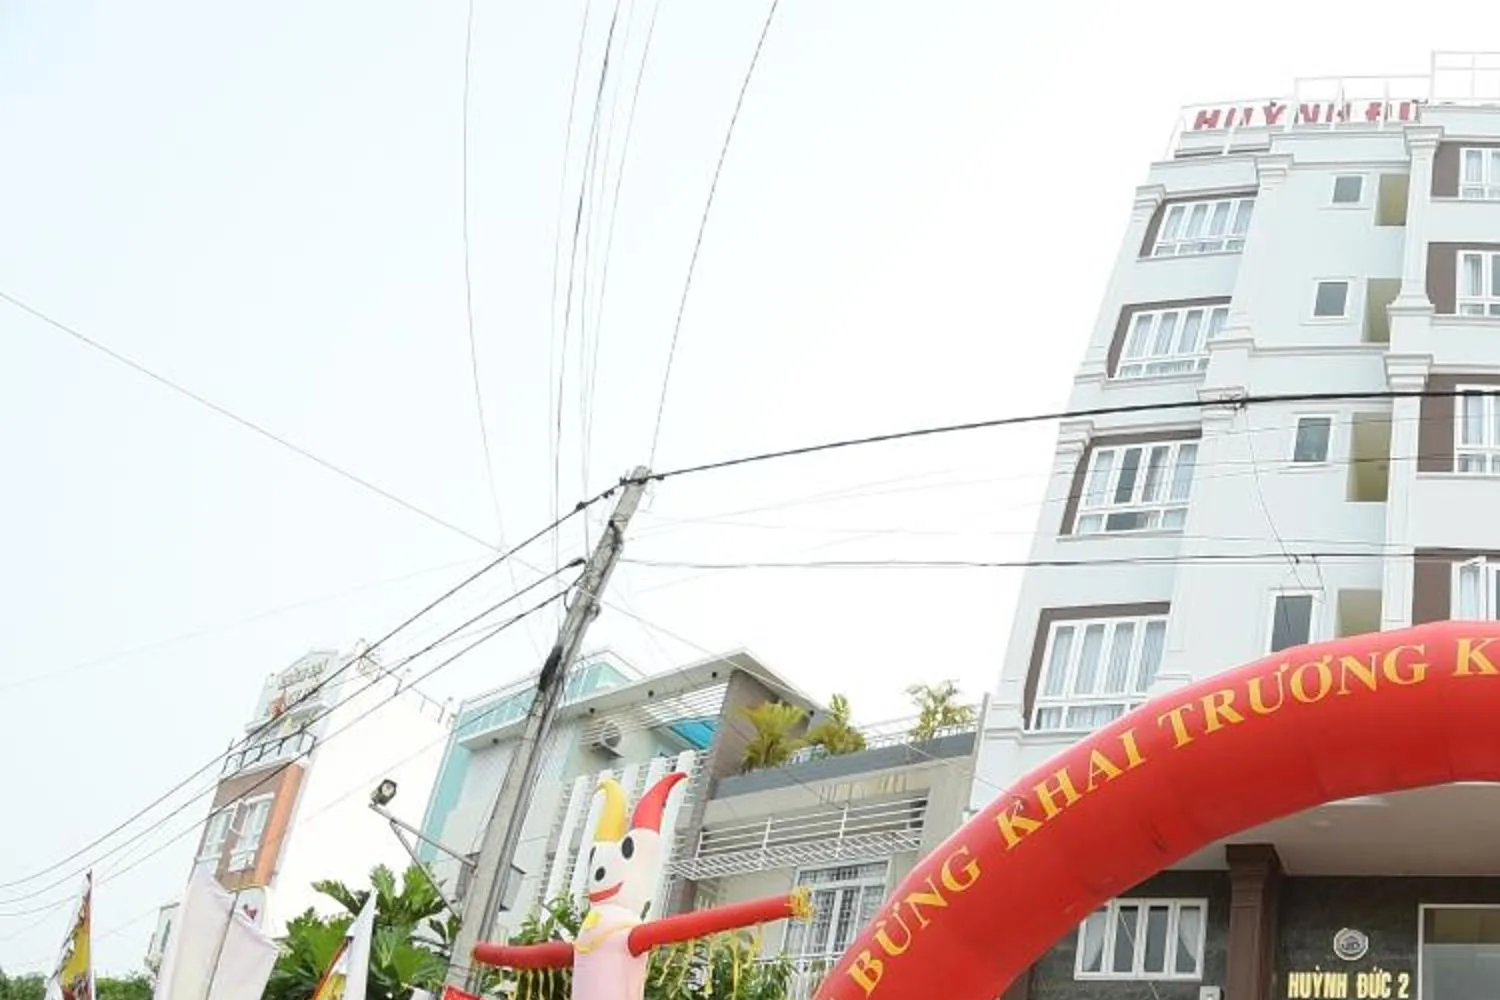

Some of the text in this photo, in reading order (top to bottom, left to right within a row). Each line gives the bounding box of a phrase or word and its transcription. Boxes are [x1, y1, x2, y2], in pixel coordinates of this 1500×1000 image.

[845, 845, 984, 997] BỪNG
[995, 727, 1147, 850] KHAI
[1157, 644, 1428, 751] TRƯƠNG
[1288, 964, 1410, 999] HUỲNH ĐỨC 2
